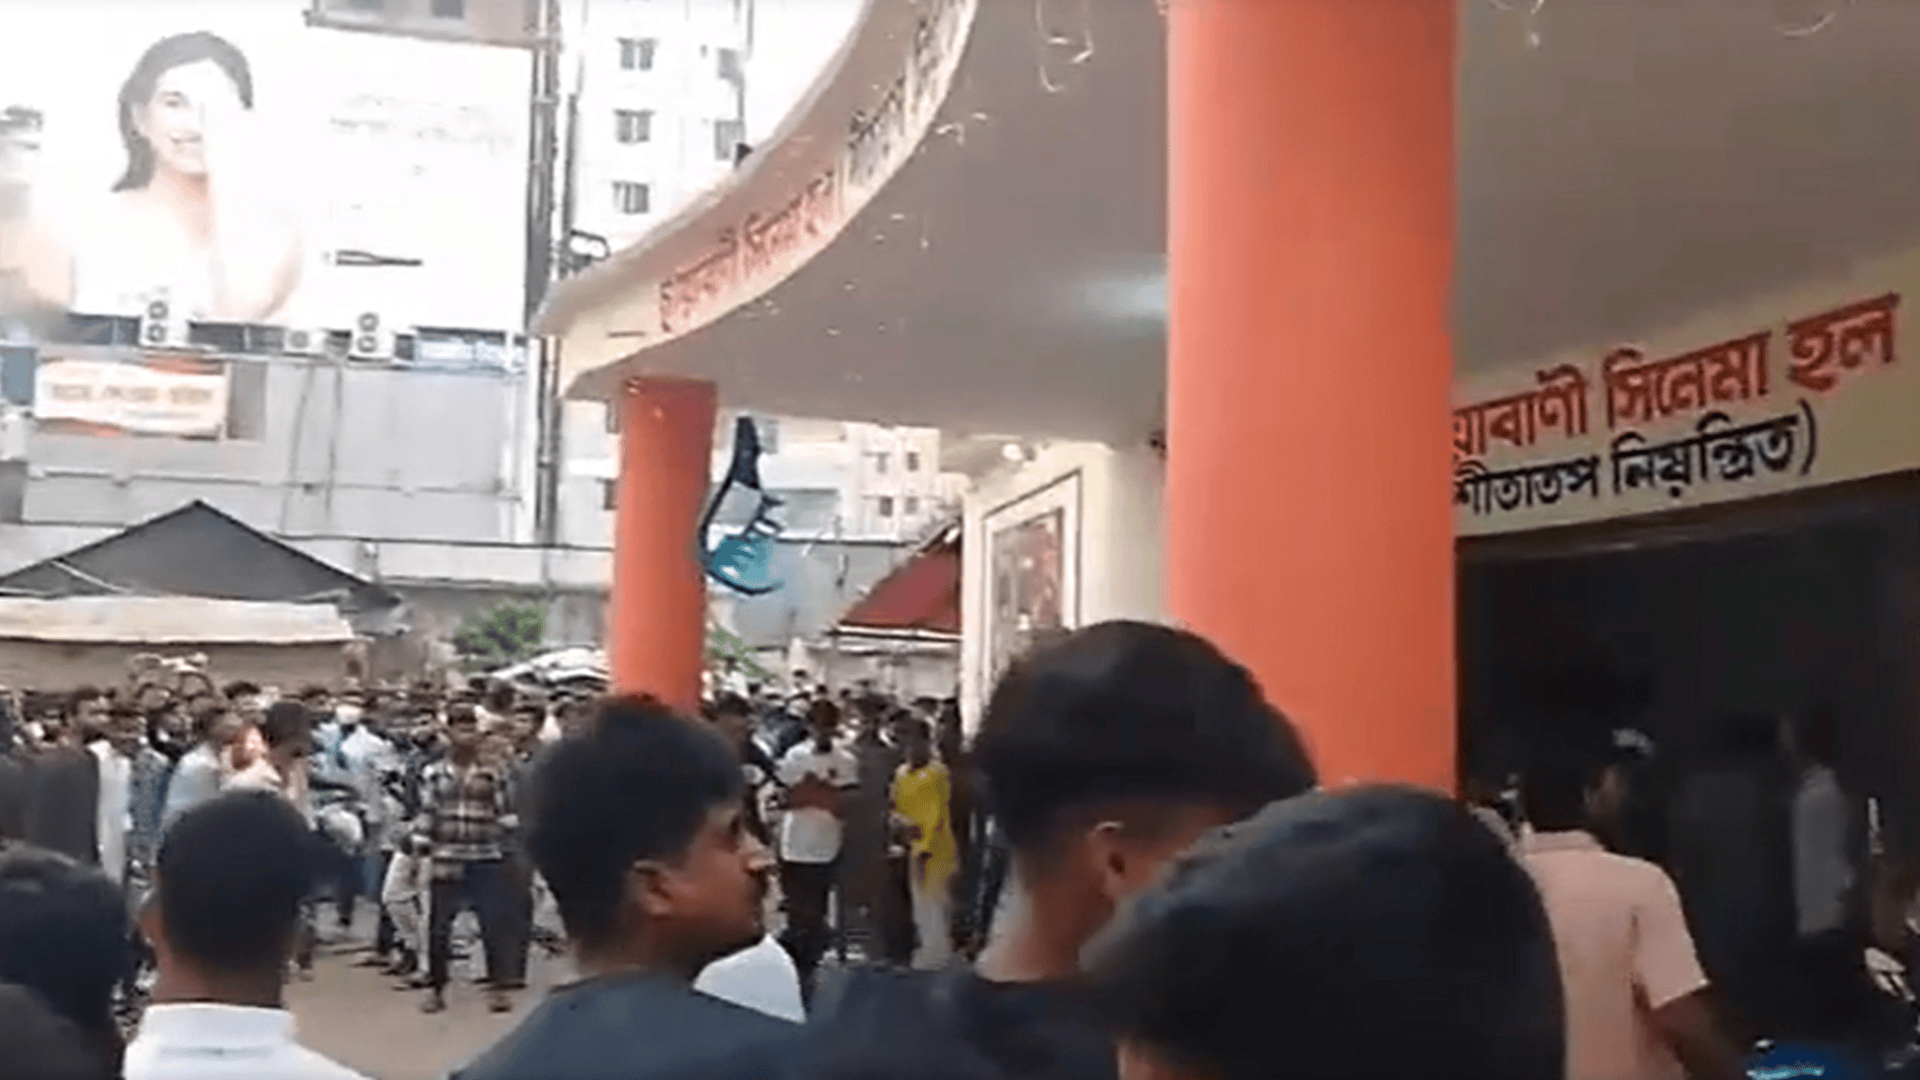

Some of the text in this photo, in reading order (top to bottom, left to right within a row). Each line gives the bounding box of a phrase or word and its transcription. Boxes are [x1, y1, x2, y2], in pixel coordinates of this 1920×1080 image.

[1453, 291, 1901, 464] য়াবাণী সিনেমা হল
[1453, 454, 1600, 516] শীতাতপ
